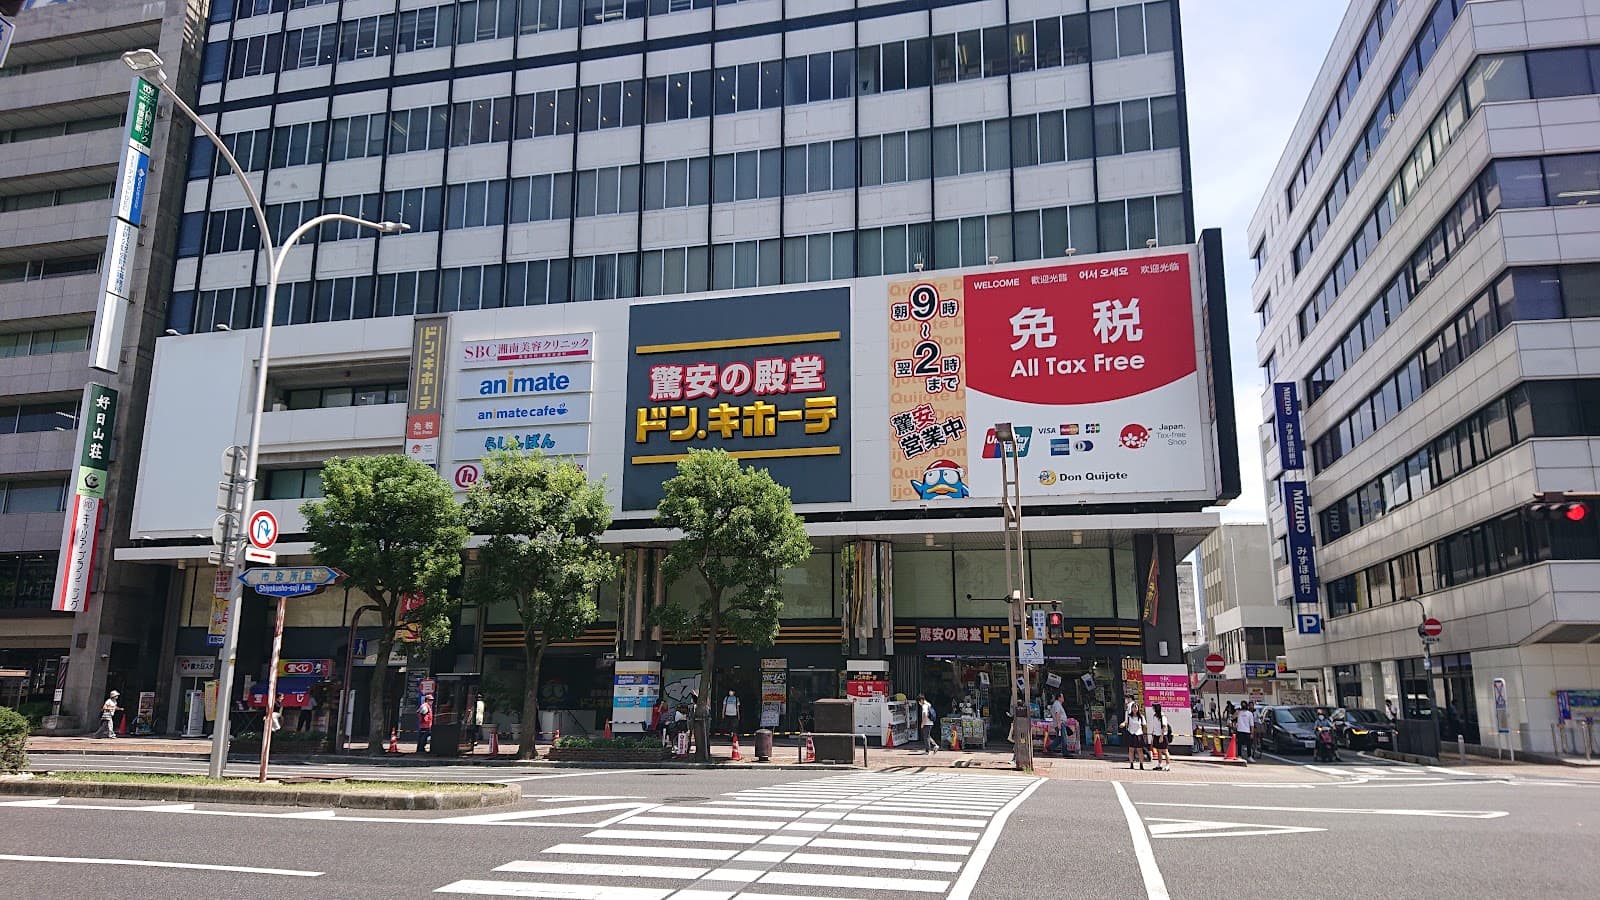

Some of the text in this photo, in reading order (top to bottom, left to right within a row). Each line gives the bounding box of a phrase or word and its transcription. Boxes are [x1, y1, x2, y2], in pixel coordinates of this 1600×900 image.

[974, 278, 1020, 290] WELCOME
[1079, 266, 1128, 280] 어서 오세요
[892, 284, 958, 320] 朝9時
[464, 337, 589, 360] SBC 湘南美容クリニック
[895, 341, 959, 376] 翌2時
[650, 354, 825, 401] 驚安の殿堂
[1010, 352, 1145, 378] All Tax Free
[480, 369, 570, 395] animate
[926, 376, 959, 392] まで
[1282, 386, 1293, 415] MIZUHO
[88, 394, 111, 460] 好日山荘
[899, 417, 966, 459] 営業中
[1156, 431, 1187, 439] Tax-free
[1167, 438, 1187, 446] Shop
[1060, 470, 1128, 483] Don Quijote
[1292, 489, 1307, 533] MIZUHO
[1297, 546, 1311, 594] みずほ銀行
[919, 626, 983, 642] 驚安の殿堂
[1302, 615, 1317, 632] P
